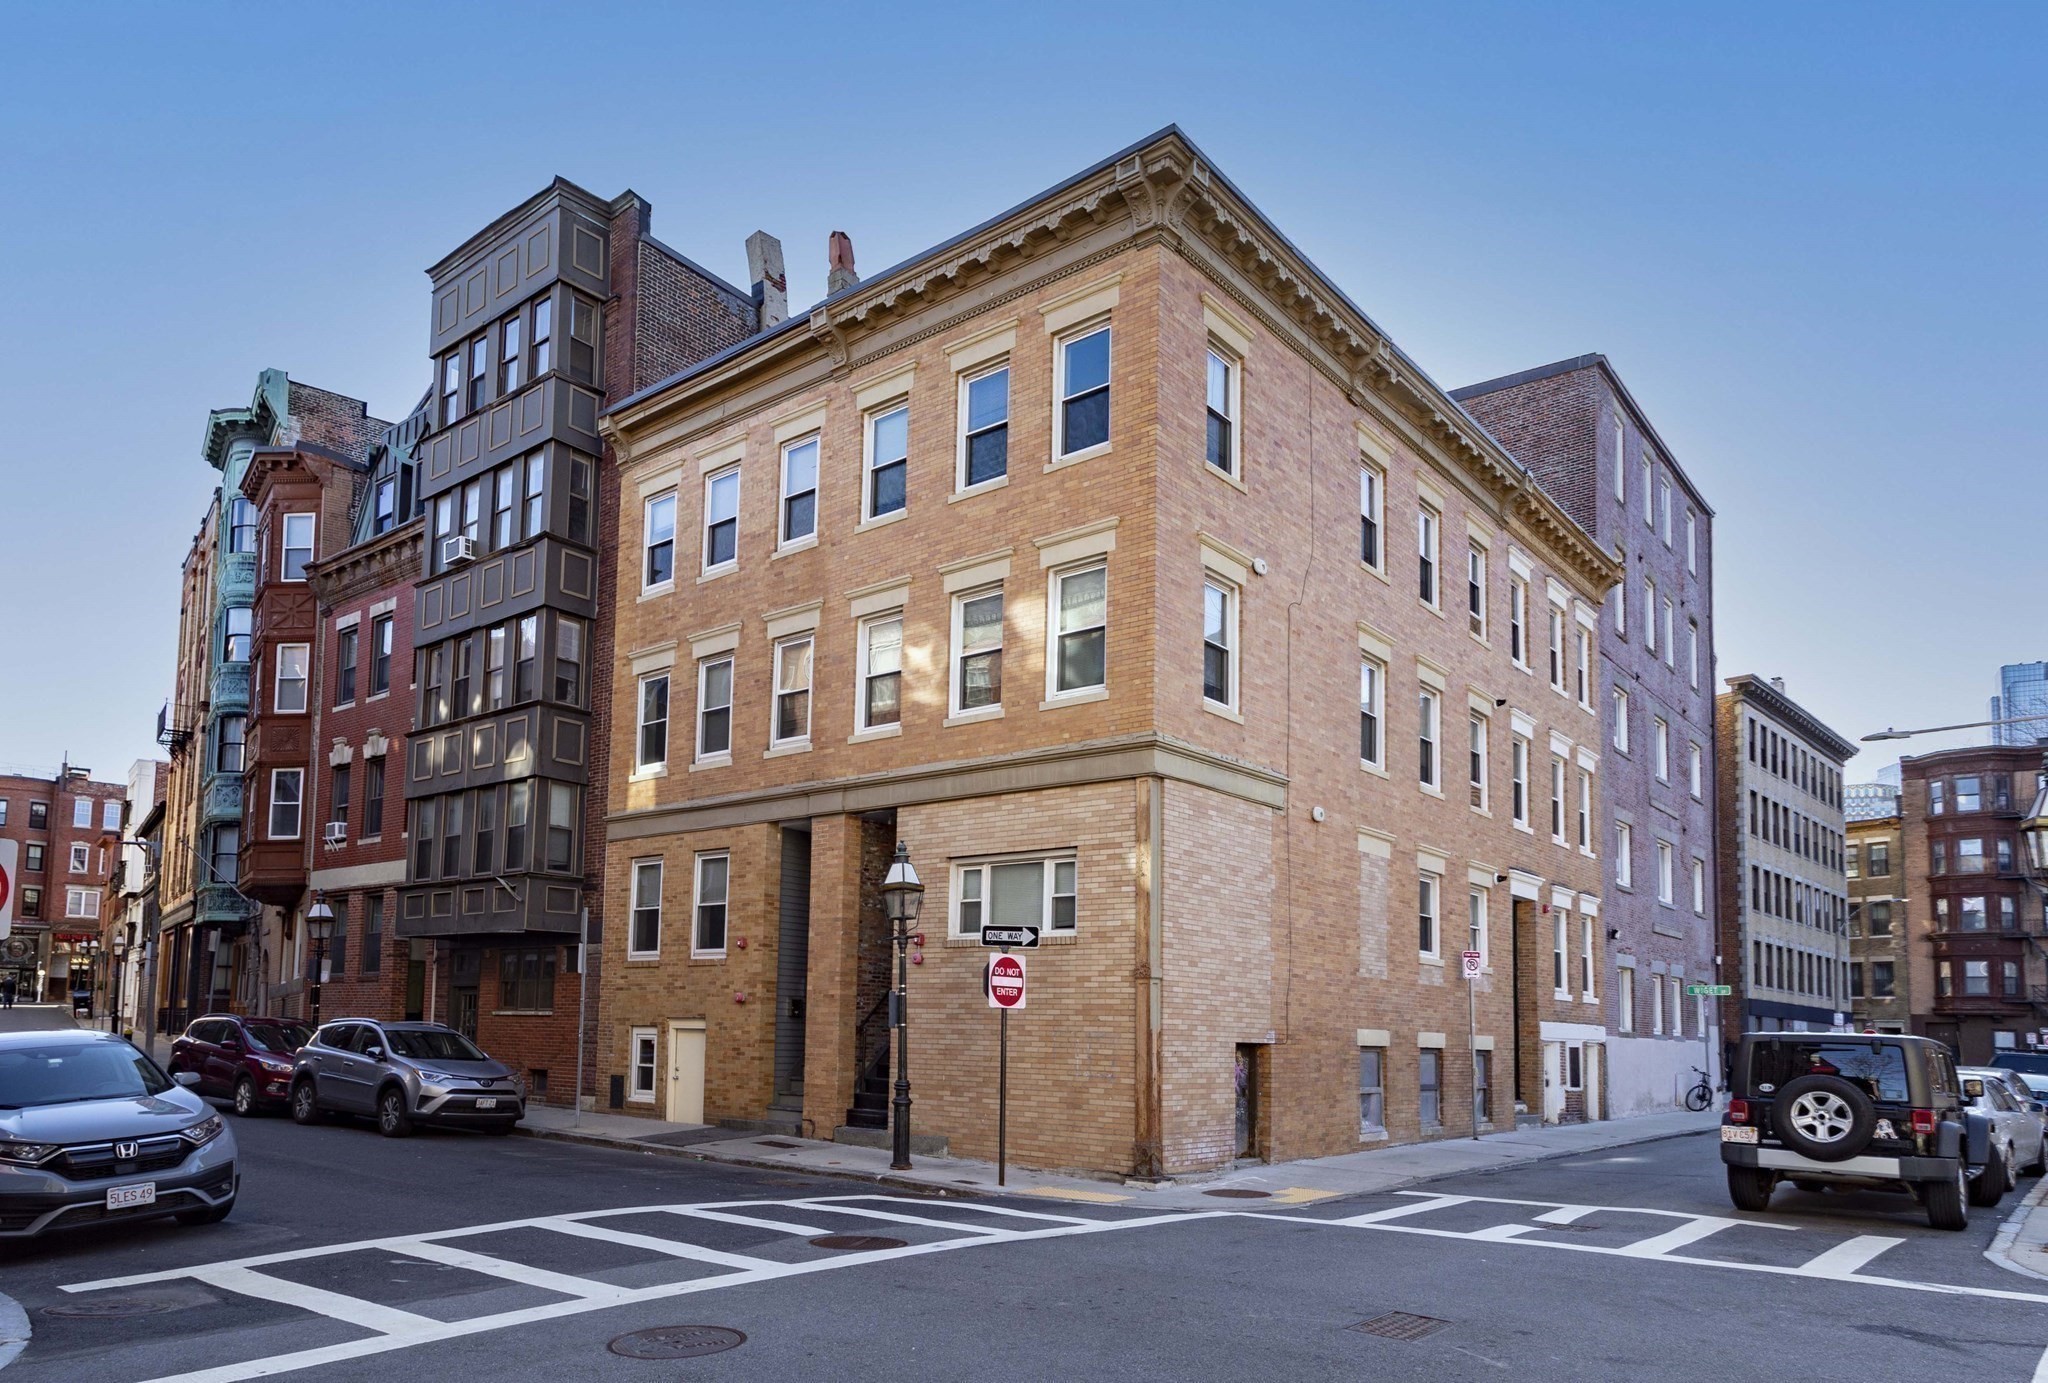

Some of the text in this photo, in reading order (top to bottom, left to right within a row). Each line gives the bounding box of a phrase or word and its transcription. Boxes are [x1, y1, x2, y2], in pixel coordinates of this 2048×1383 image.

[988, 932, 1022, 940] ONE WAY
[994, 967, 1020, 976] DO NOT
[996, 988, 1018, 996] ENTER
[110, 1188, 152, 1204] 5LES 49
